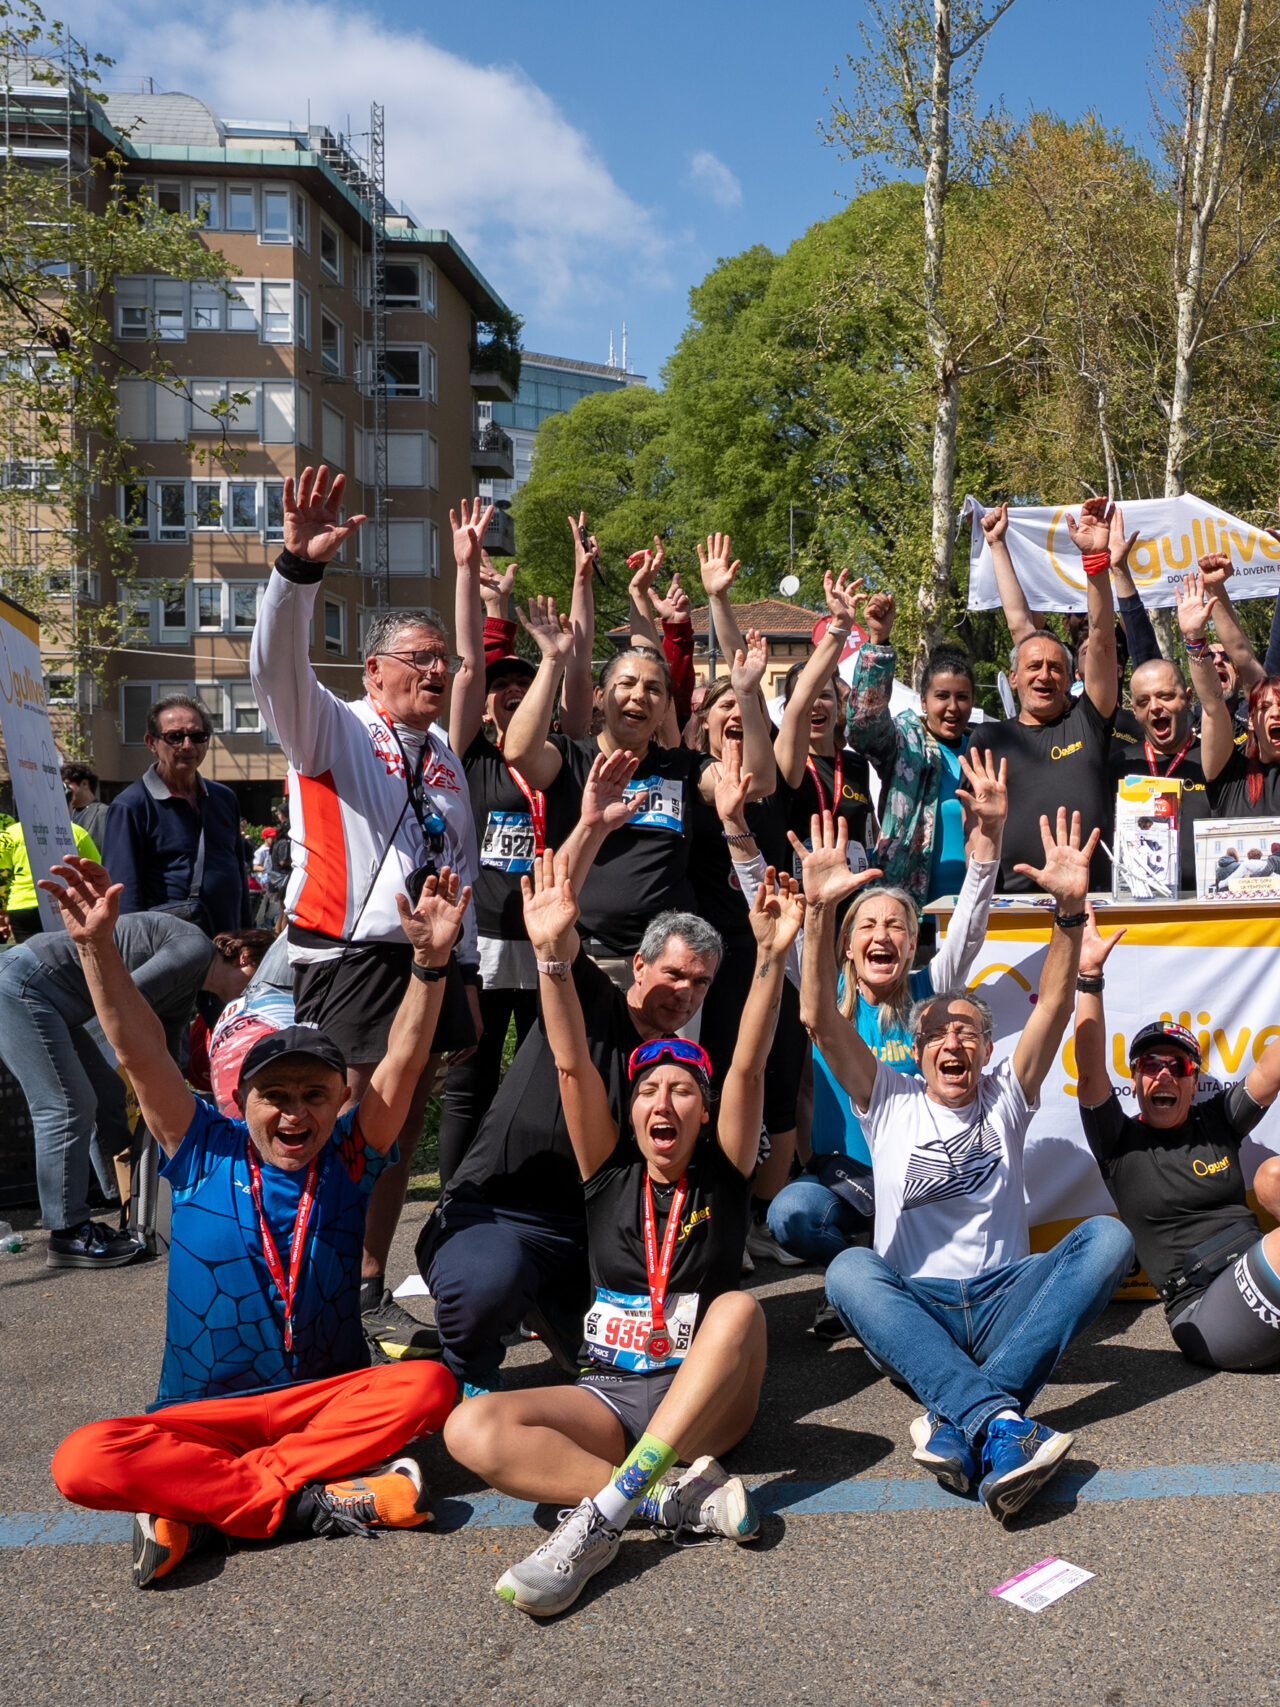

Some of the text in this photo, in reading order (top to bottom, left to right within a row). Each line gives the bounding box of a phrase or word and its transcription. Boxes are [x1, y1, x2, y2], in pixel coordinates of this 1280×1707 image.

[1243, 565, 1275, 577] DIVENTA
[501, 834, 535, 858] 927
[291, 1228, 303, 1264] MARATHON
[647, 1239, 655, 1274] MARATHON
[661, 1242, 671, 1277] UNICREDIT
[605, 1317, 652, 1351] 935
